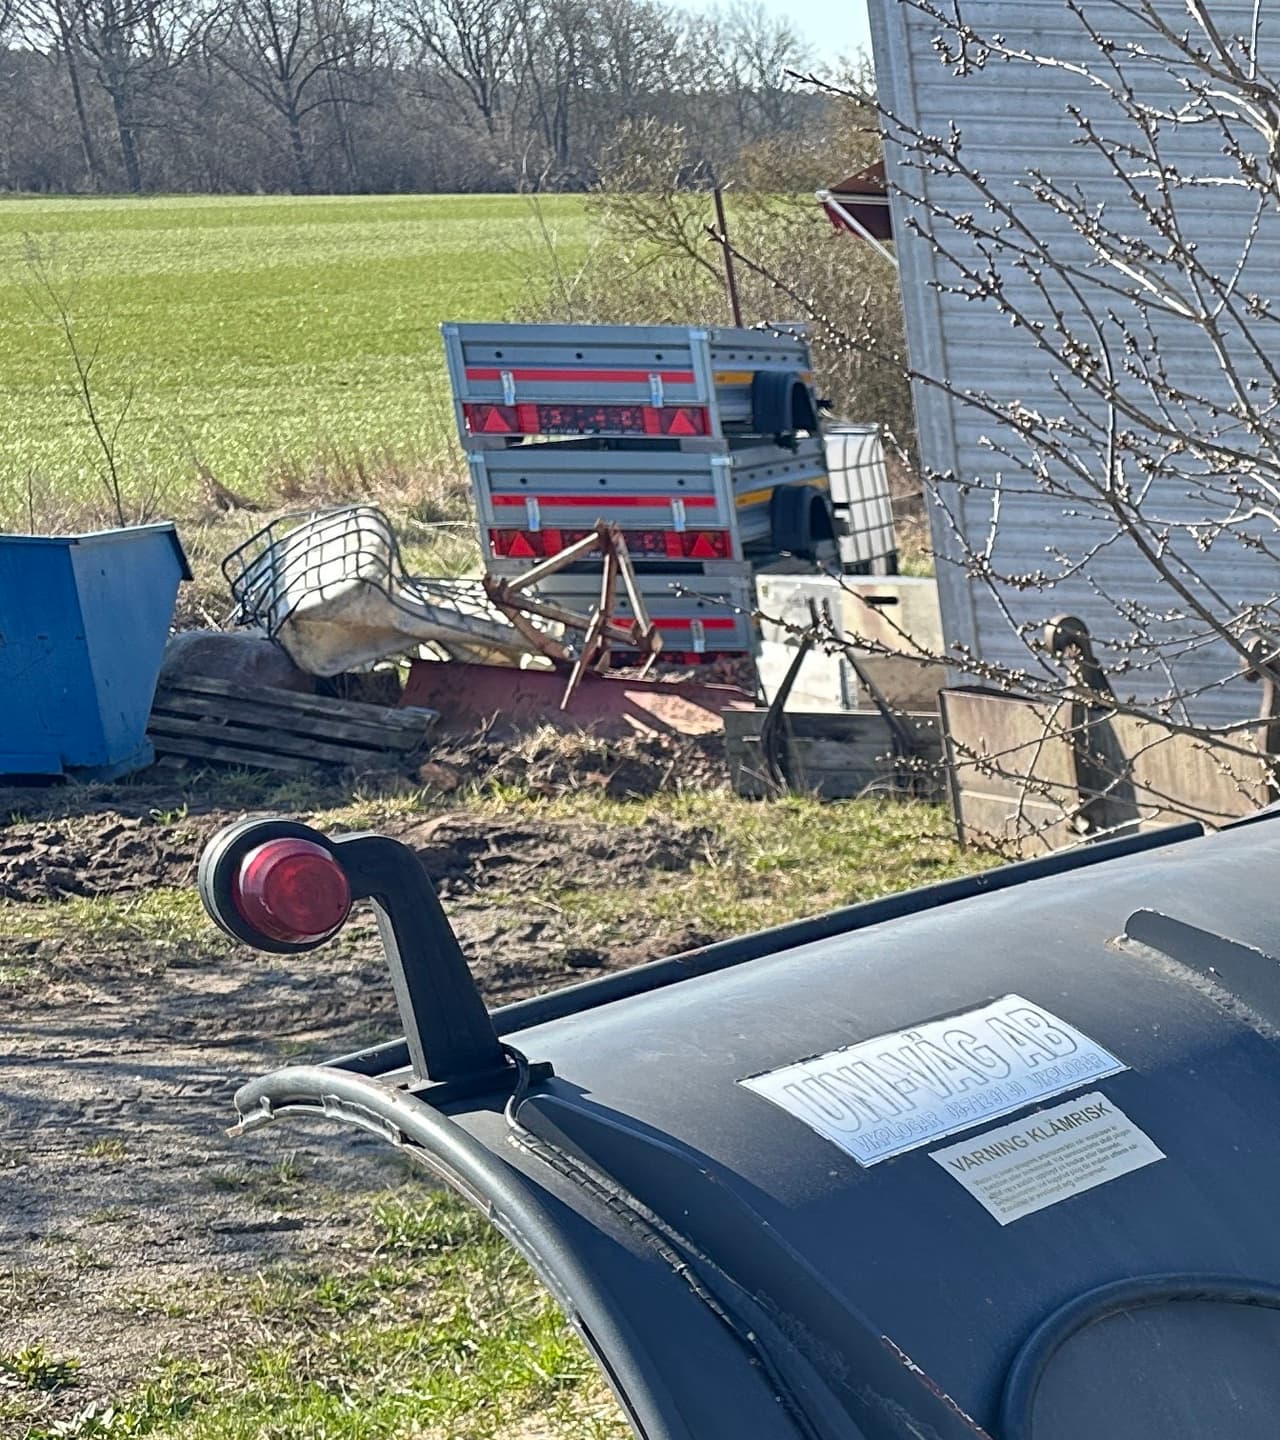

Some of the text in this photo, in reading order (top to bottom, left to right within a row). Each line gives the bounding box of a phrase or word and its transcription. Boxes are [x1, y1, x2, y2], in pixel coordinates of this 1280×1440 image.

[783, 1008, 1078, 1133] UNI-VÄG AB
[947, 1134, 1028, 1172] VARNING
[1025, 1102, 1113, 1144] KLÄMRISK
